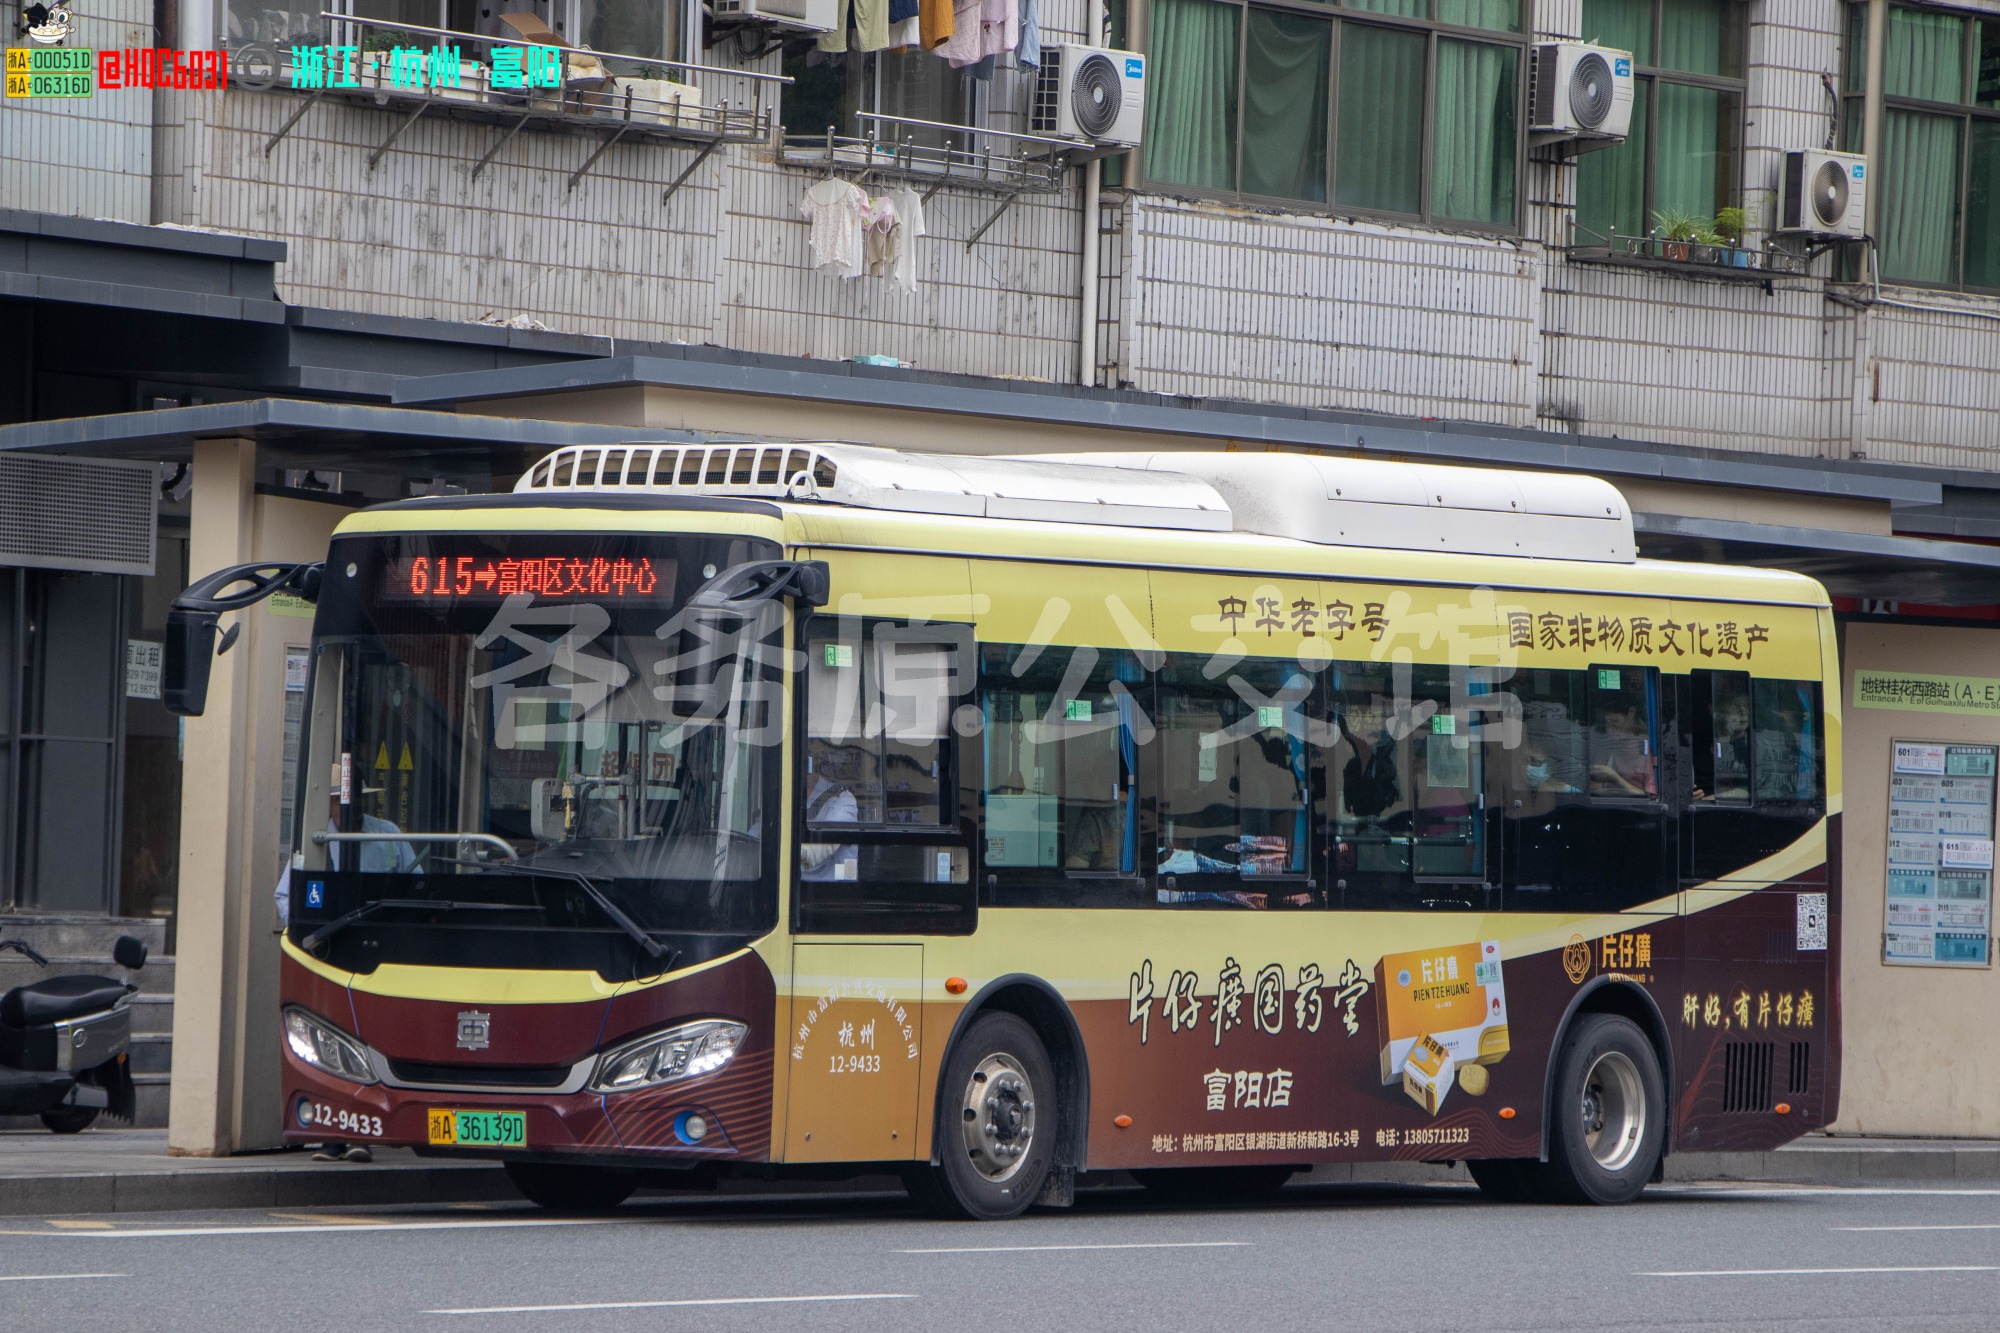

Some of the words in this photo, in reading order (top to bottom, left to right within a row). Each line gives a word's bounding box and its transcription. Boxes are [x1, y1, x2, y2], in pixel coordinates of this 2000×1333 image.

[411, 557, 473, 595] 615
[497, 557, 657, 596] 富阳区文化中心
[1217, 596, 1391, 643] 中华老字号
[1506, 610, 1770, 661] 国家非物质文化遗产
[1861, 693, 1896, 704] Entrance
[1897, 695, 1904, 704] A
[1909, 696, 1916, 705] E
[1925, 698, 1966, 708] Guihuaxilu
[1966, 701, 1990, 709] Metro
[1898, 748, 1910, 757] 601
[1941, 780, 1954, 788] 605
[1946, 843, 1959, 851] 615
[1413, 986, 1430, 1002] PIEN
[1431, 985, 1445, 1000] TZE
[1445, 982, 1470, 998] HUANG
[838, 1018, 876, 1050] 杭州
[829, 1055, 881, 1073] 12-9433
[1203, 1067, 1293, 1111] 富阳店
[314, 1103, 383, 1137] 12-9433
